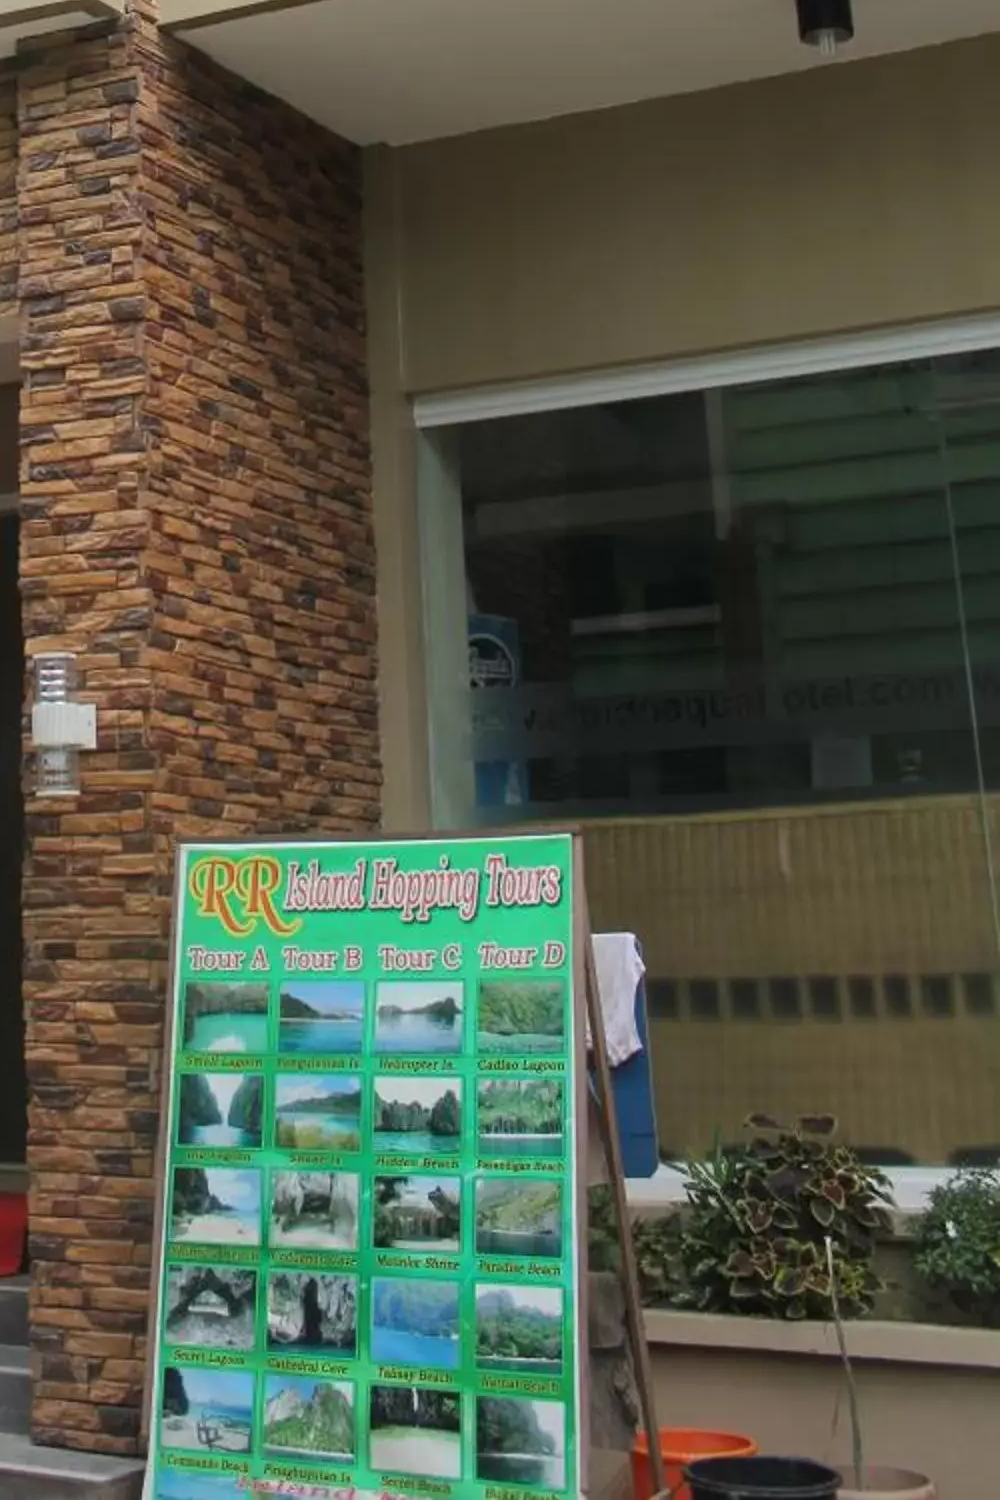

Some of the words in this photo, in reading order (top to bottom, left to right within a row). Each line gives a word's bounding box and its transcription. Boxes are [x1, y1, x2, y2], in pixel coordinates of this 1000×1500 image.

[190, 856, 302, 936] RR
[284, 859, 367, 911] Island
[370, 855, 479, 921] Hopping
[486, 853, 560, 905] Tours
[188, 945, 245, 970] Tour
[251, 945, 270, 970] A
[282, 945, 338, 970] Tour
[343, 946, 362, 970] B
[378, 944, 436, 971] Tour
[442, 944, 461, 969] C
[479, 941, 536, 968] Tour
[543, 941, 565, 967] D
[522, 1059, 565, 1073] Lagoon
